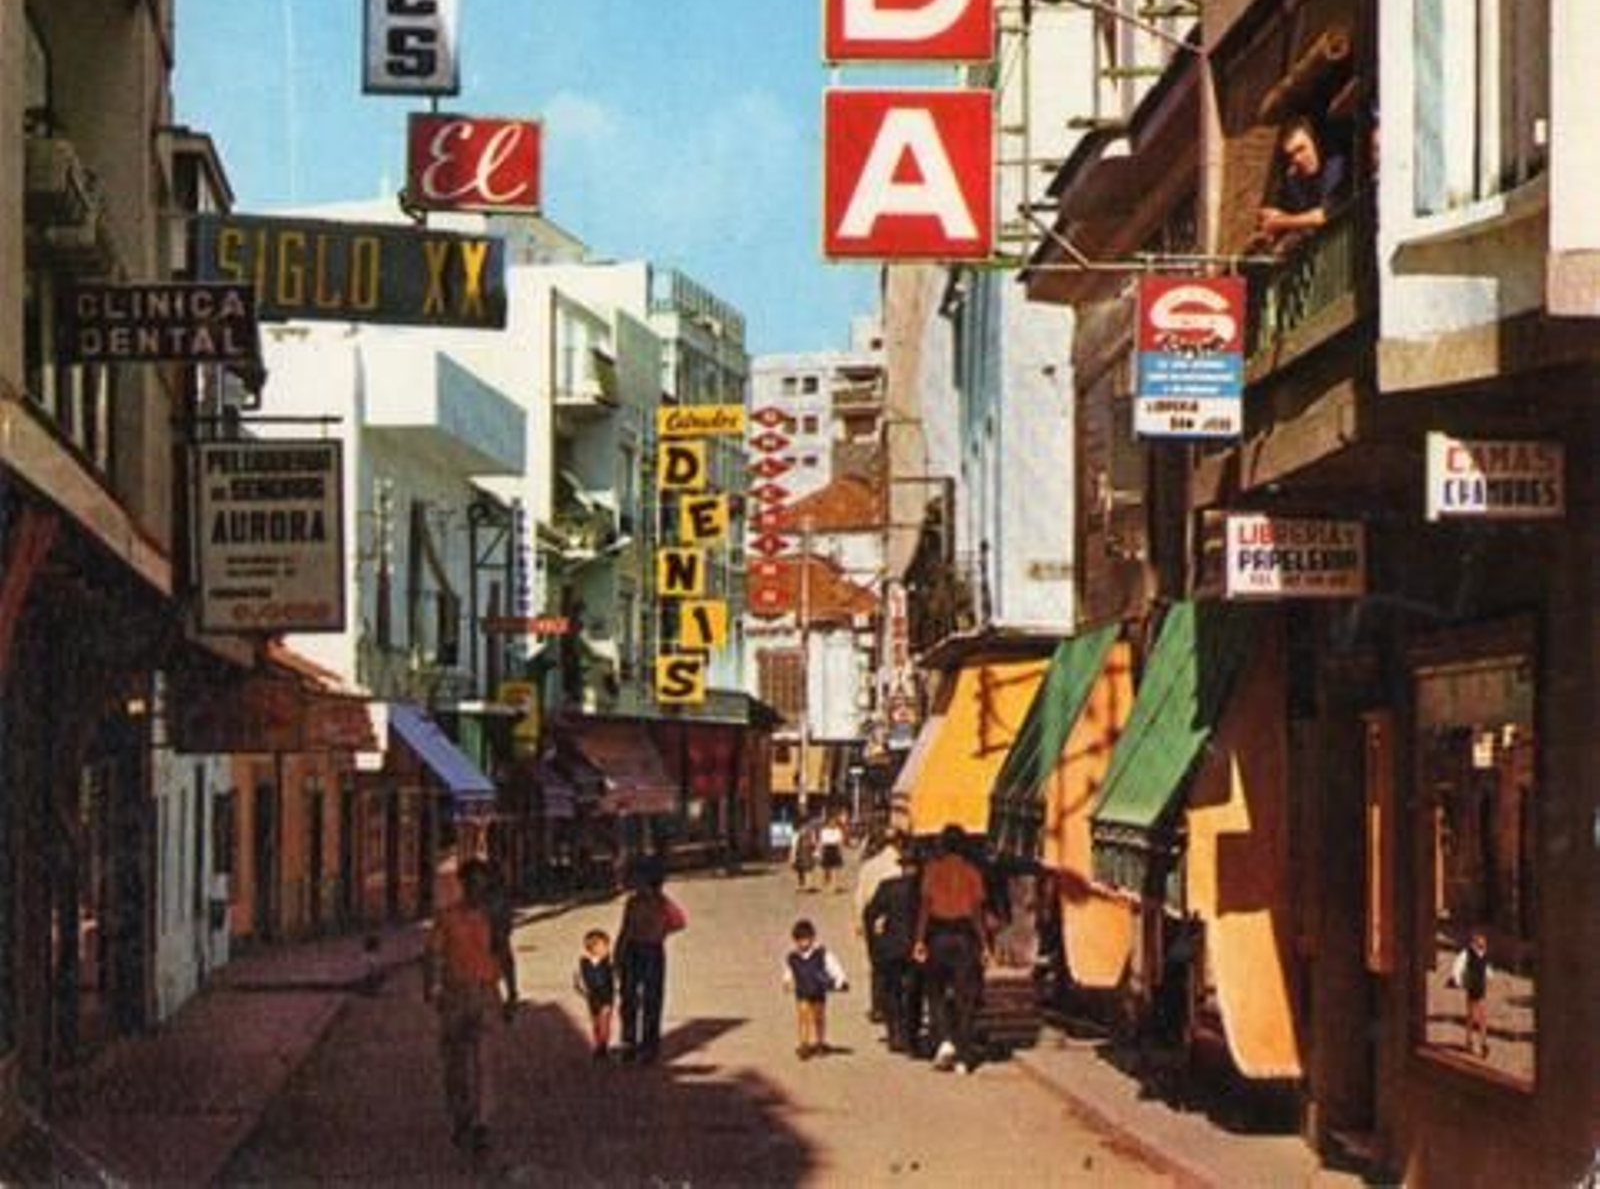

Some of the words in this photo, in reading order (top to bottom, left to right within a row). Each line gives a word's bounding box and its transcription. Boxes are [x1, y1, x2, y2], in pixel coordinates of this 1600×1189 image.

[421, 122, 529, 206] El
[217, 227, 381, 311] SIGLO
[422, 238, 490, 316] XX
[77, 289, 246, 318] CLINICA
[80, 326, 244, 356] DENTAL
[210, 511, 325, 544] AURORA
[661, 446, 719, 697] DENIS
